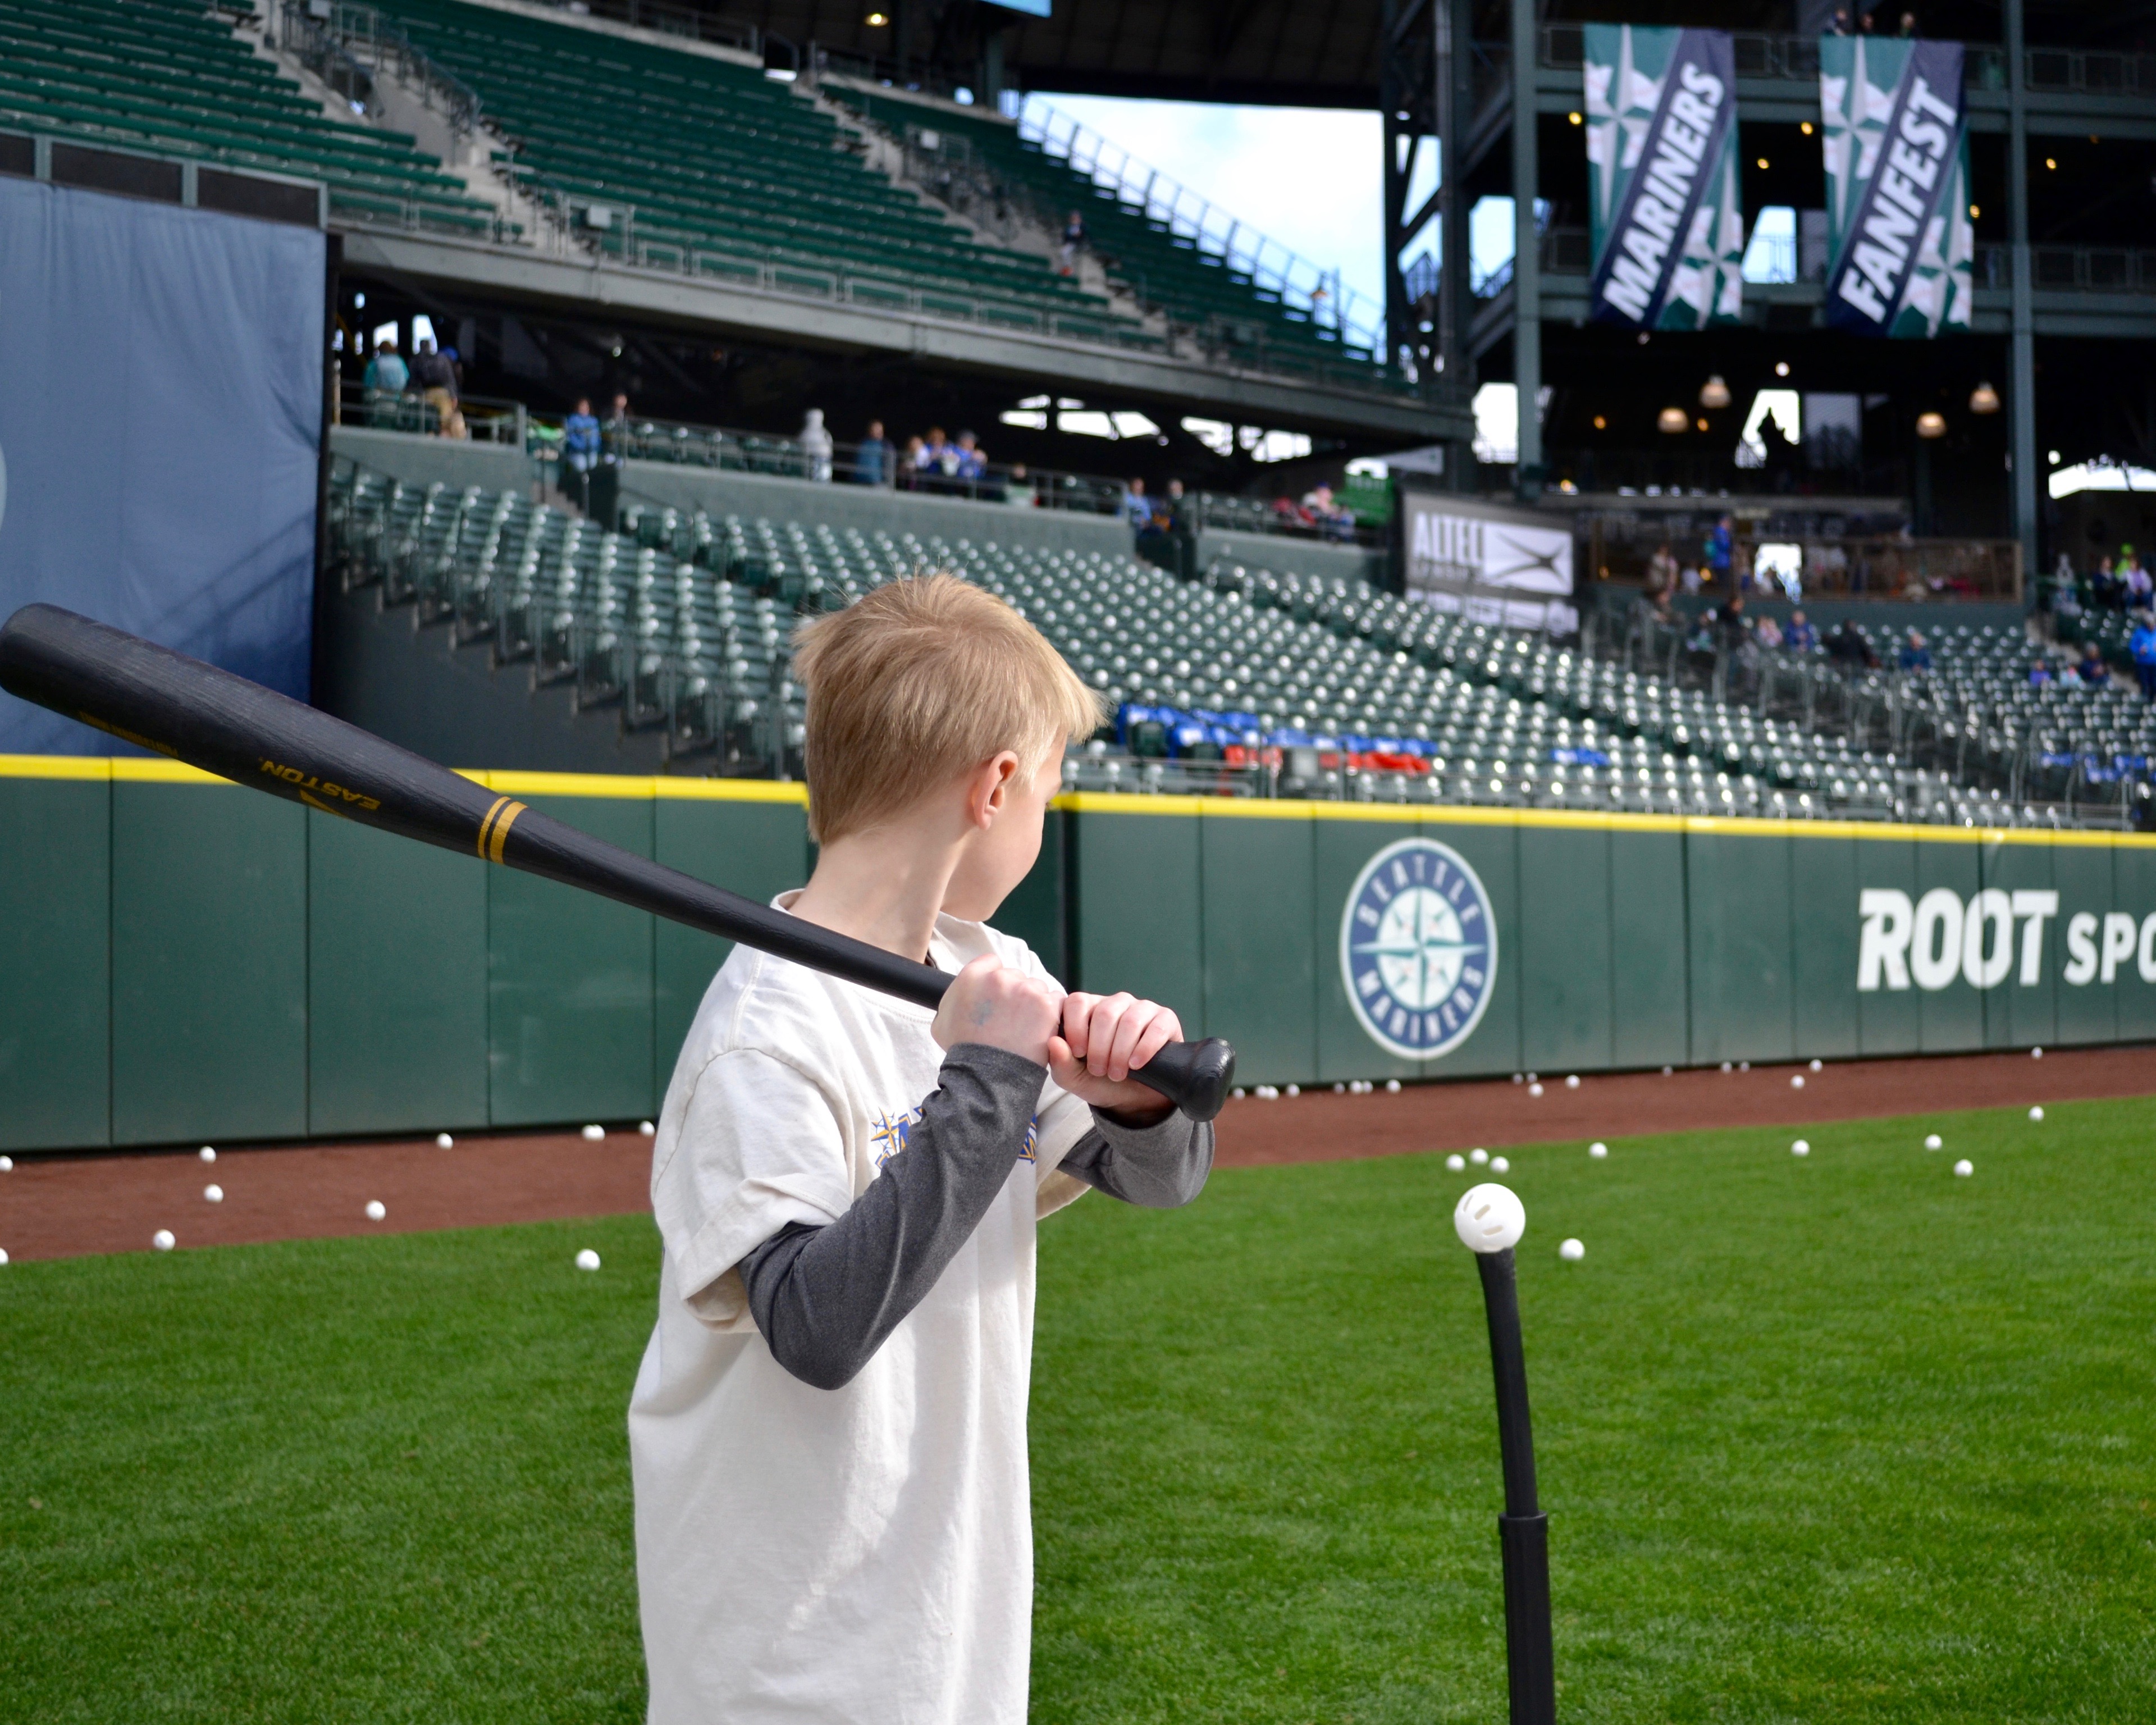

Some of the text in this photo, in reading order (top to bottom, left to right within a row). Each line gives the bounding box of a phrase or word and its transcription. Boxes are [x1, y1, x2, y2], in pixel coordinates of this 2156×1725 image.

[1602, 61, 1725, 322] MARINERS
[1839, 76, 1958, 324] FANFEST
[261, 760, 381, 810] EASTON
[1356, 853, 1481, 928] SEATTLE
[1857, 888, 2059, 992] ROOT
[1357, 965, 1484, 1044] MARINERS
